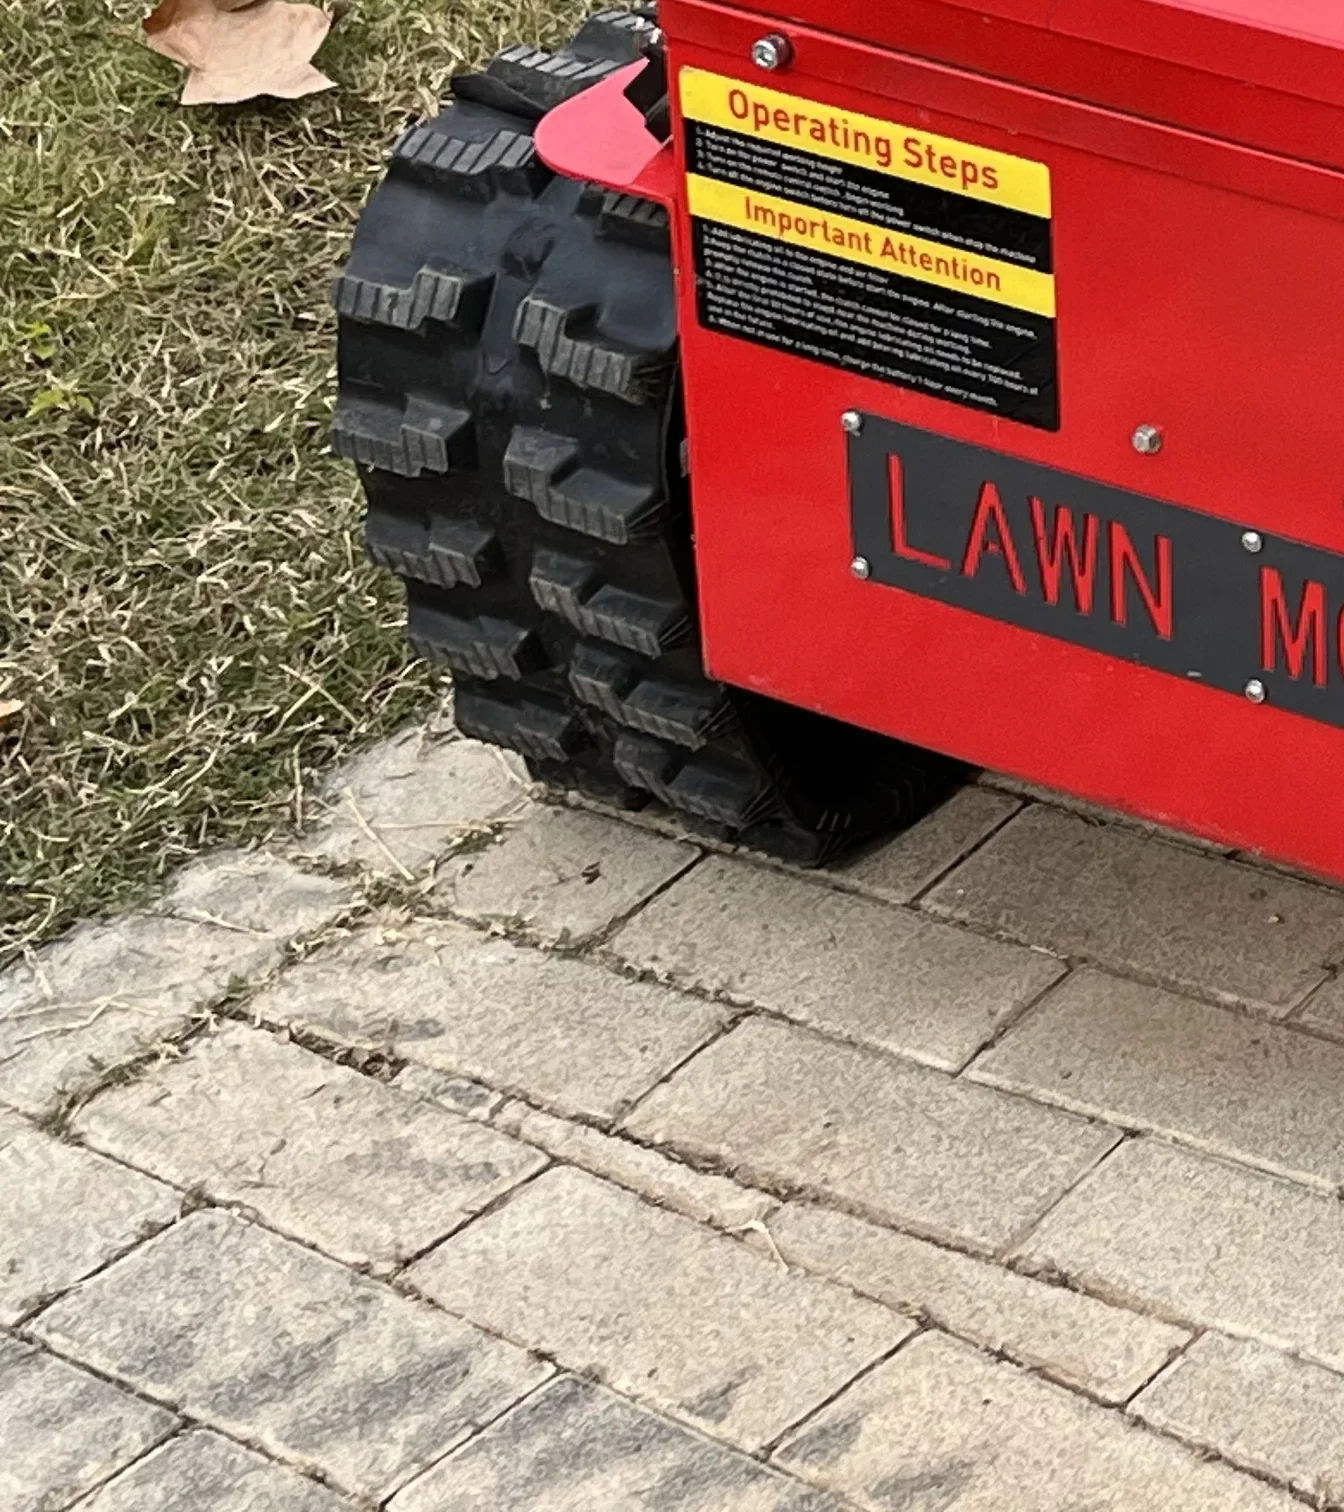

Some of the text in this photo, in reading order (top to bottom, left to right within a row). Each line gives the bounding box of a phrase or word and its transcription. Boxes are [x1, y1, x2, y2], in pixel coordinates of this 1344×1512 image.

[728, 88, 1000, 190] Operating Steps
[744, 195, 1002, 292] Important Attention
[886, 452, 1175, 643] LAWN
